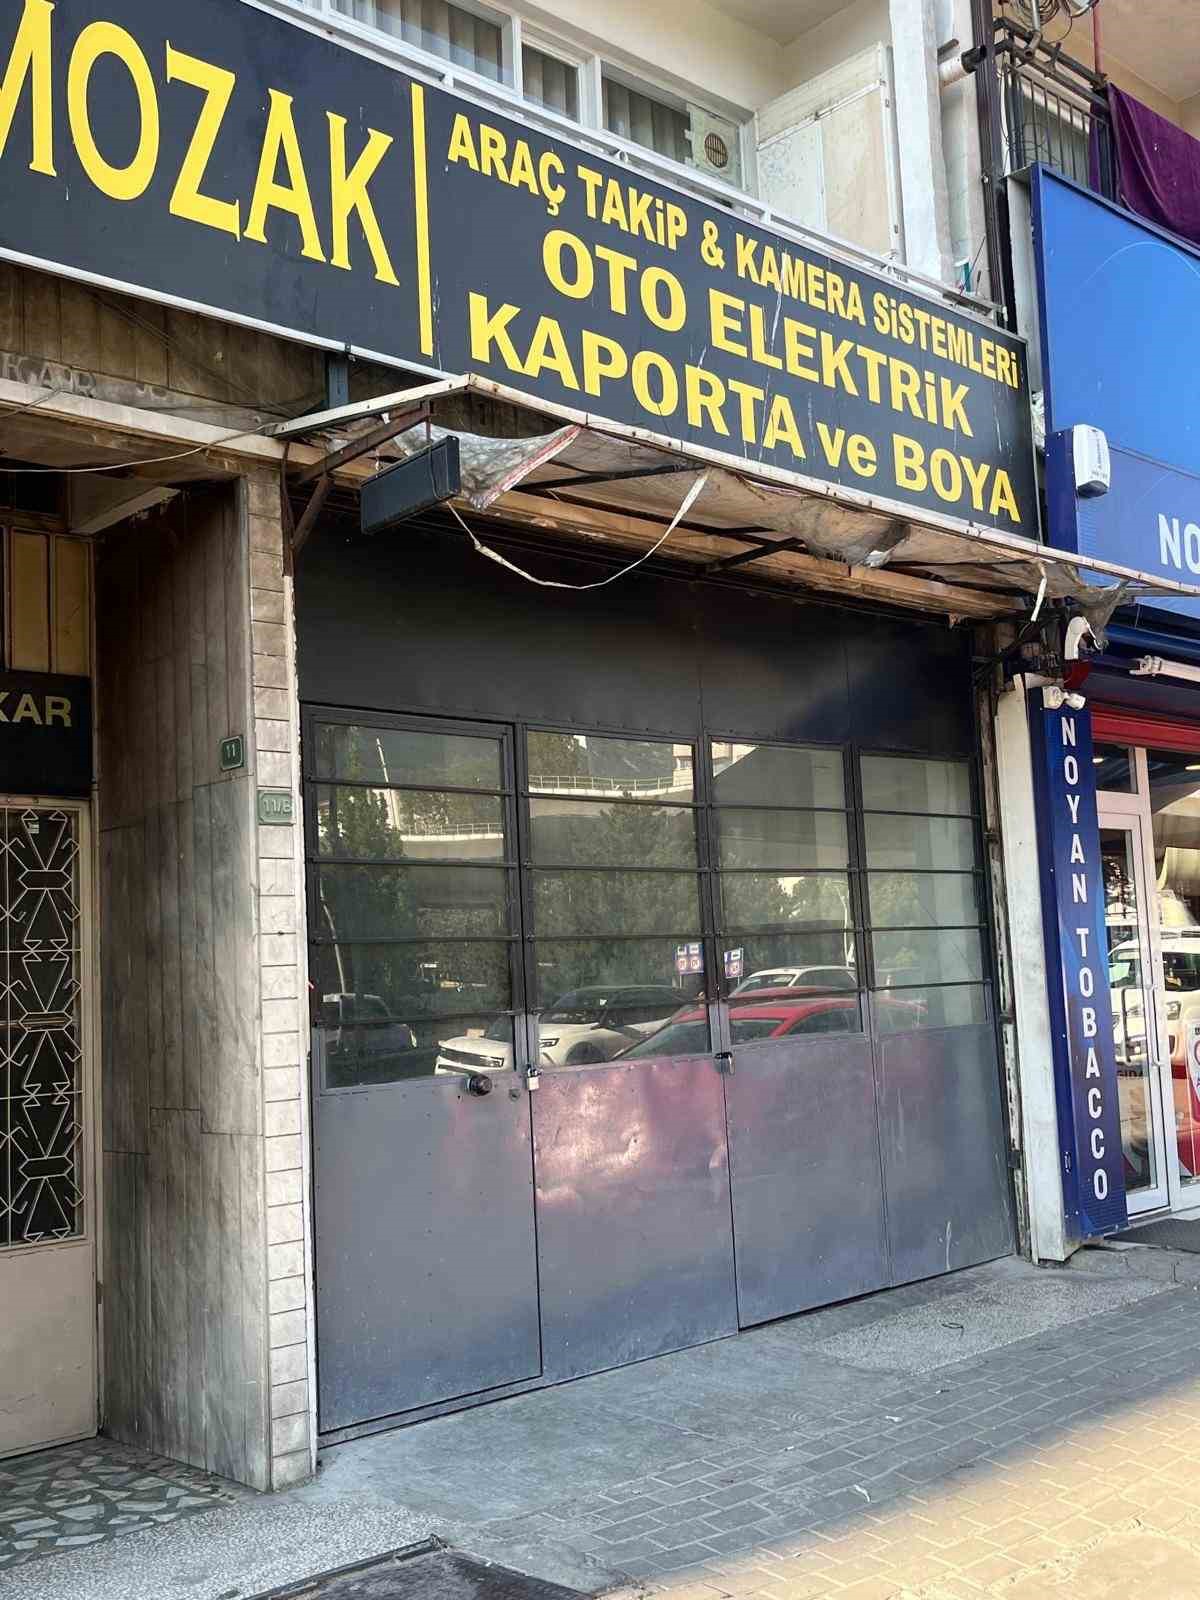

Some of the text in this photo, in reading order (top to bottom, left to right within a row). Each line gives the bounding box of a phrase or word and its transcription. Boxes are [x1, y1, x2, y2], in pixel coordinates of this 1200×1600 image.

[448, 113, 566, 216] ARAÇ
[700, 219, 725, 270] &
[735, 232, 867, 327] KAMERA
[542, 229, 687, 333] OTO
[468, 291, 807, 460] KAPORTA
[816, 421, 878, 478] ve
[893, 433, 1022, 523] BOYA
[1060, 716, 1108, 1201] NOYAN TOBACCO
